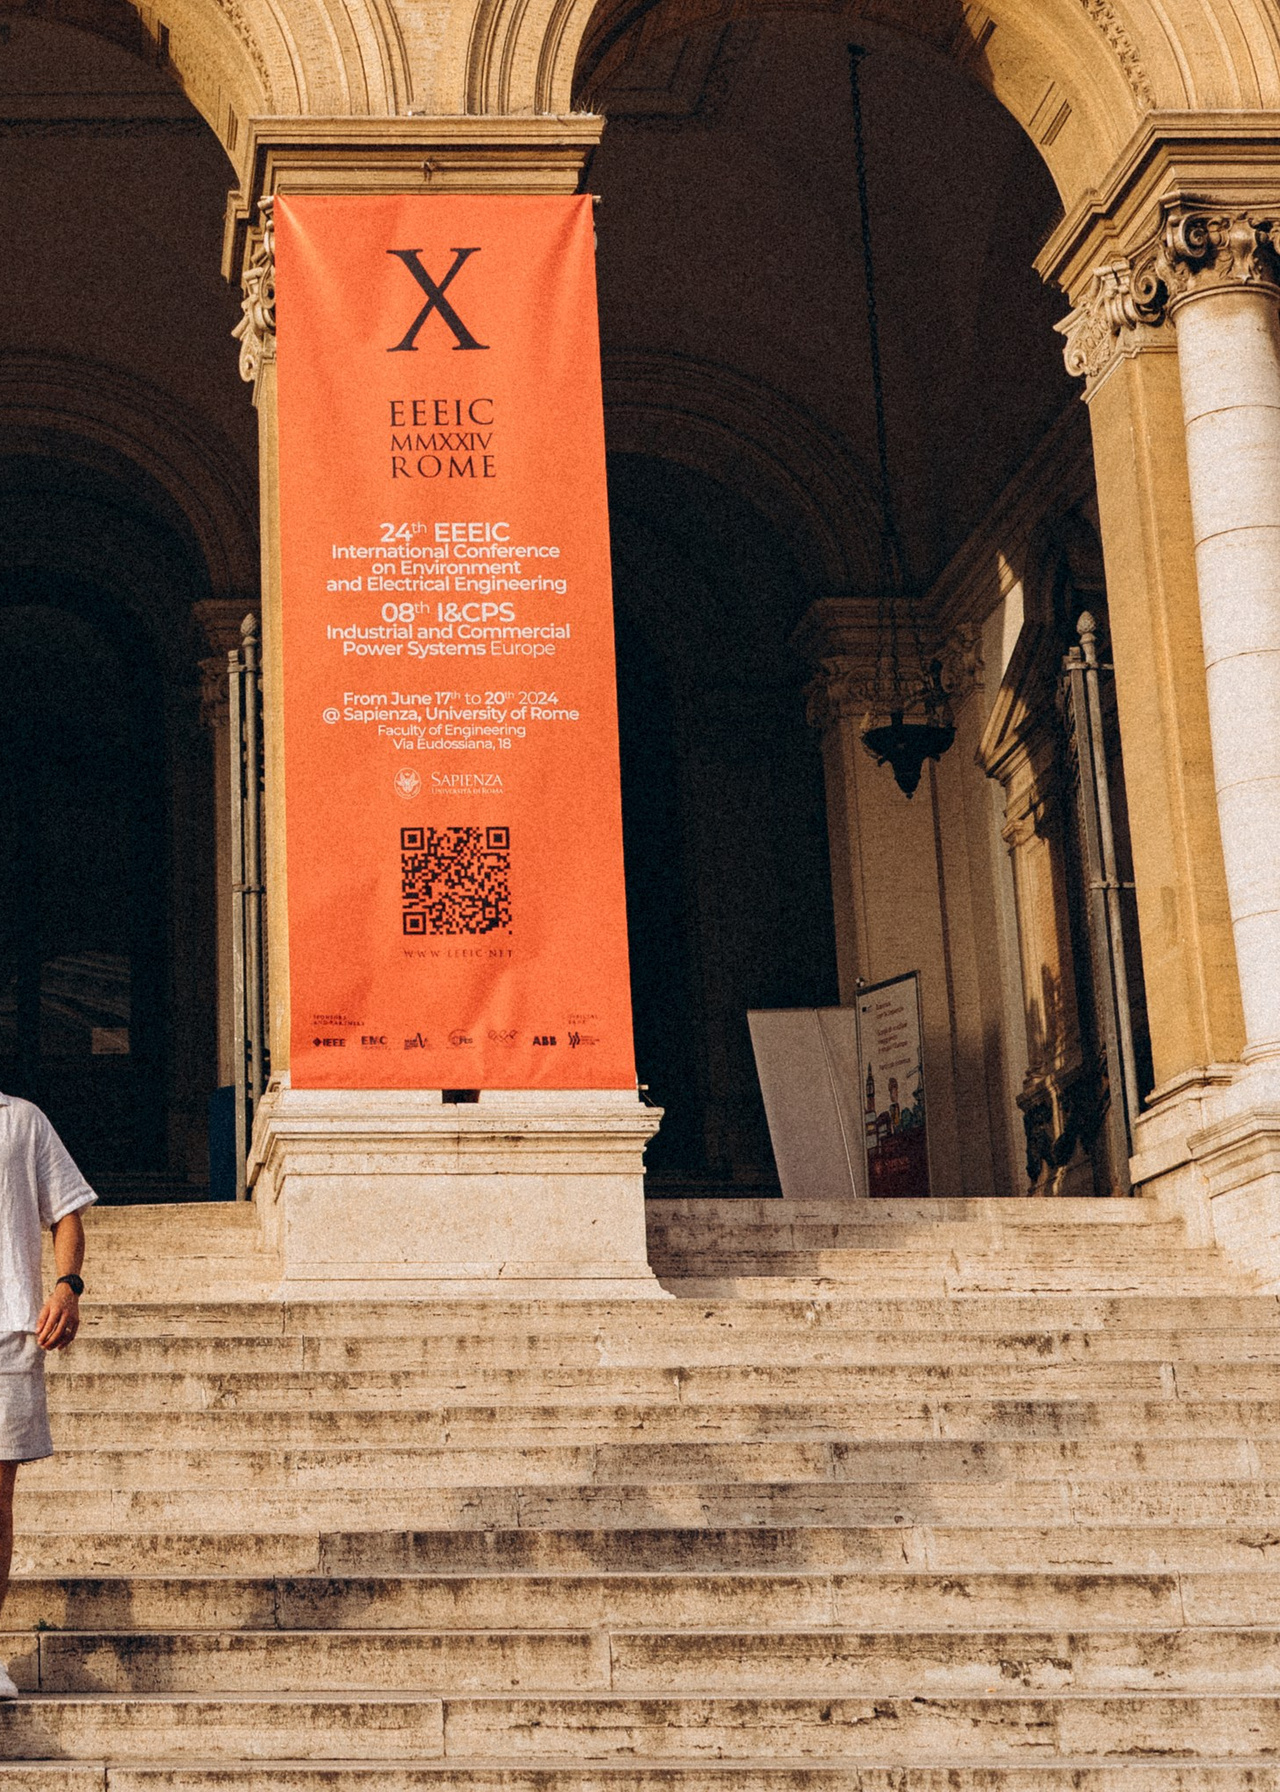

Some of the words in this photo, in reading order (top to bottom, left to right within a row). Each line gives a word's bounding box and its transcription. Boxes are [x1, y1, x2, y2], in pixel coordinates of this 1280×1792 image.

[385, 246, 490, 352] X
[388, 398, 495, 427] EEEIC
[390, 432, 494, 451] MMXXIV
[391, 454, 497, 479] ROME
[379, 521, 427, 542] 24th
[434, 522, 510, 542] EEEIC
[332, 543, 449, 559] International
[453, 543, 561, 558] Conference
[371, 562, 396, 575] on
[400, 560, 521, 575] Environment
[326, 576, 362, 591] and
[367, 575, 449, 591] Electrical
[455, 574, 567, 594] Engineering
[381, 601, 430, 622] 08th
[437, 602, 515, 622] I&CPS
[326, 623, 412, 639] Industrial
[417, 623, 453, 639] and
[457, 622, 571, 639] Commercial
[343, 641, 403, 656] Power
[407, 641, 486, 659] Systems
[491, 640, 556, 658] Europe
[343, 692, 387, 705] From
[390, 691, 432, 705] June
[464, 692, 482, 705] to
[518, 691, 559, 705] 2024
[322, 707, 340, 724] @
[343, 706, 422, 724] Sapienza,
[426, 706, 507, 723] University
[510, 706, 527, 720] of
[530, 707, 580, 720] Rome
[378, 724, 426, 737] Faculty
[428, 724, 442, 736] of
[445, 724, 526, 738] Engineering
[392, 738, 413, 750] Via
[417, 738, 496, 751] Eudossiana,
[497, 738, 512, 749] 18
[322, 1038, 346, 1047] IEEE
[532, 1036, 557, 1046] ABB
